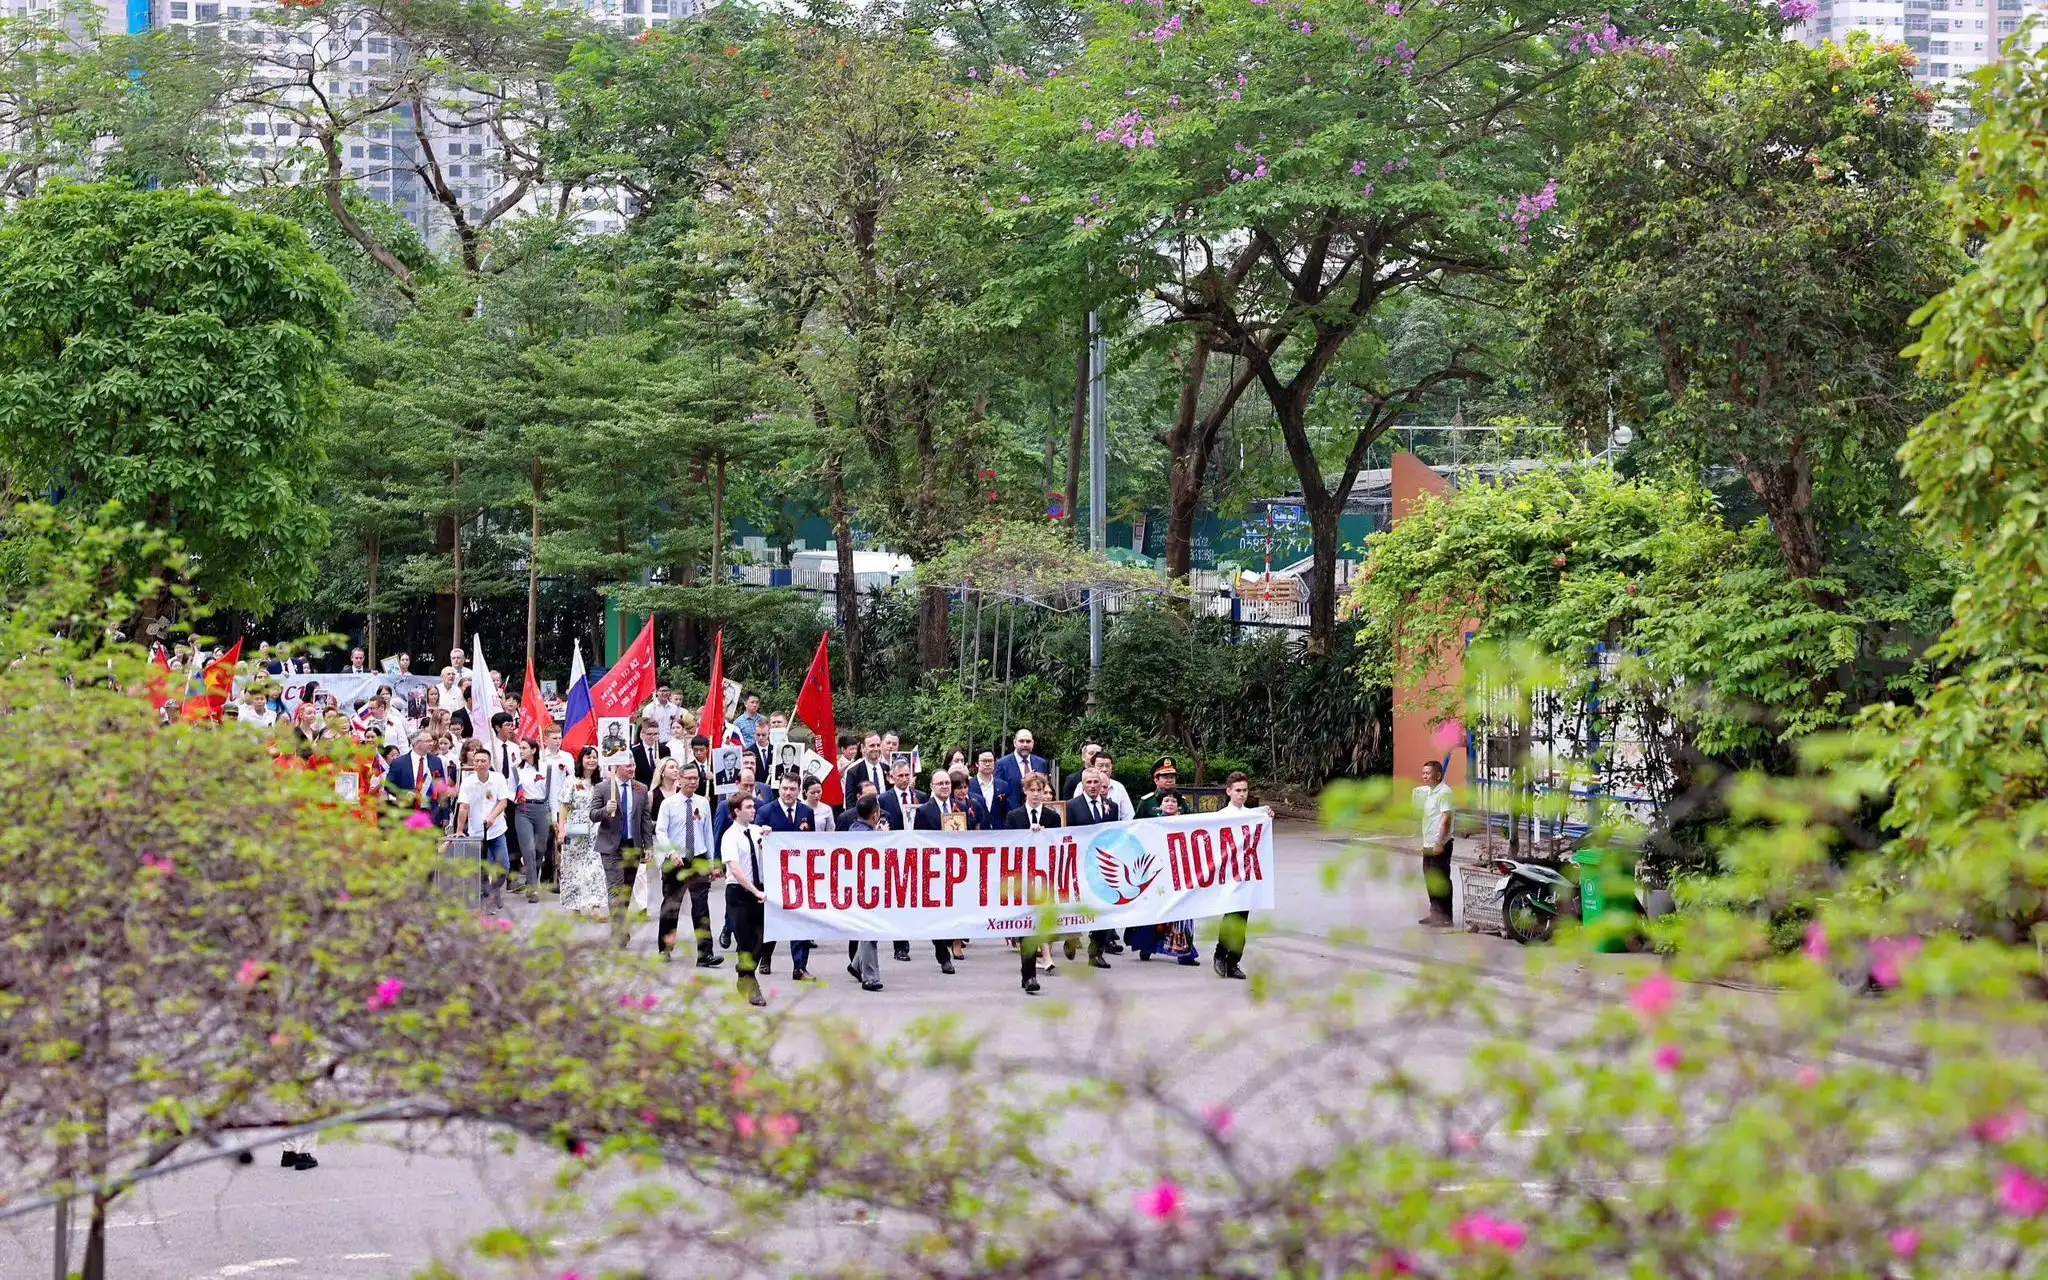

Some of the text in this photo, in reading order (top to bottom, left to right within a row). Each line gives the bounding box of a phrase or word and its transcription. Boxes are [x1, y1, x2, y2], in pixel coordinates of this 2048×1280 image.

[780, 823, 1263, 910] БЕССМЕРТНЫЙ ПОЛК
[986, 913, 1096, 931] Ханой, етнам
